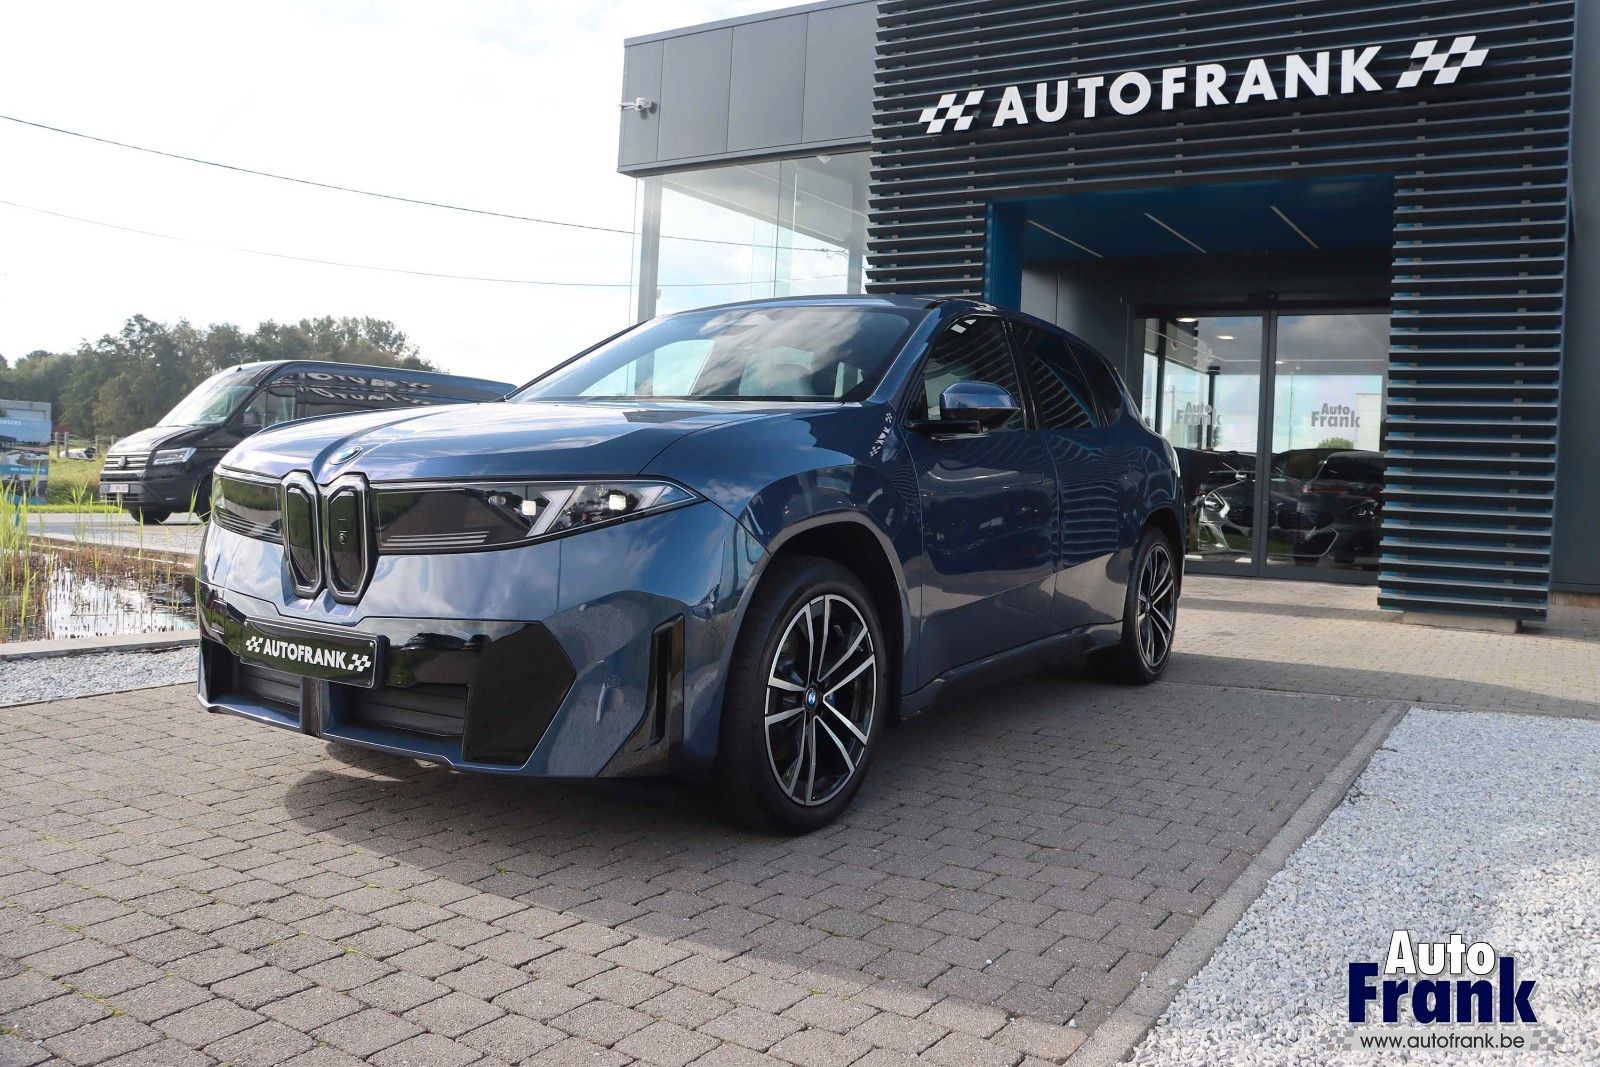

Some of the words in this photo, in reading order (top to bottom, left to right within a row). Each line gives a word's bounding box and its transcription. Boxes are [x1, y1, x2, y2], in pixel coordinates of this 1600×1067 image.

[992, 45, 1383, 127] AUTOFRANK
[1311, 410, 1361, 428] Frank
[1320, 402, 1350, 415] Auto
[263, 638, 347, 669] AUTOFRANK
